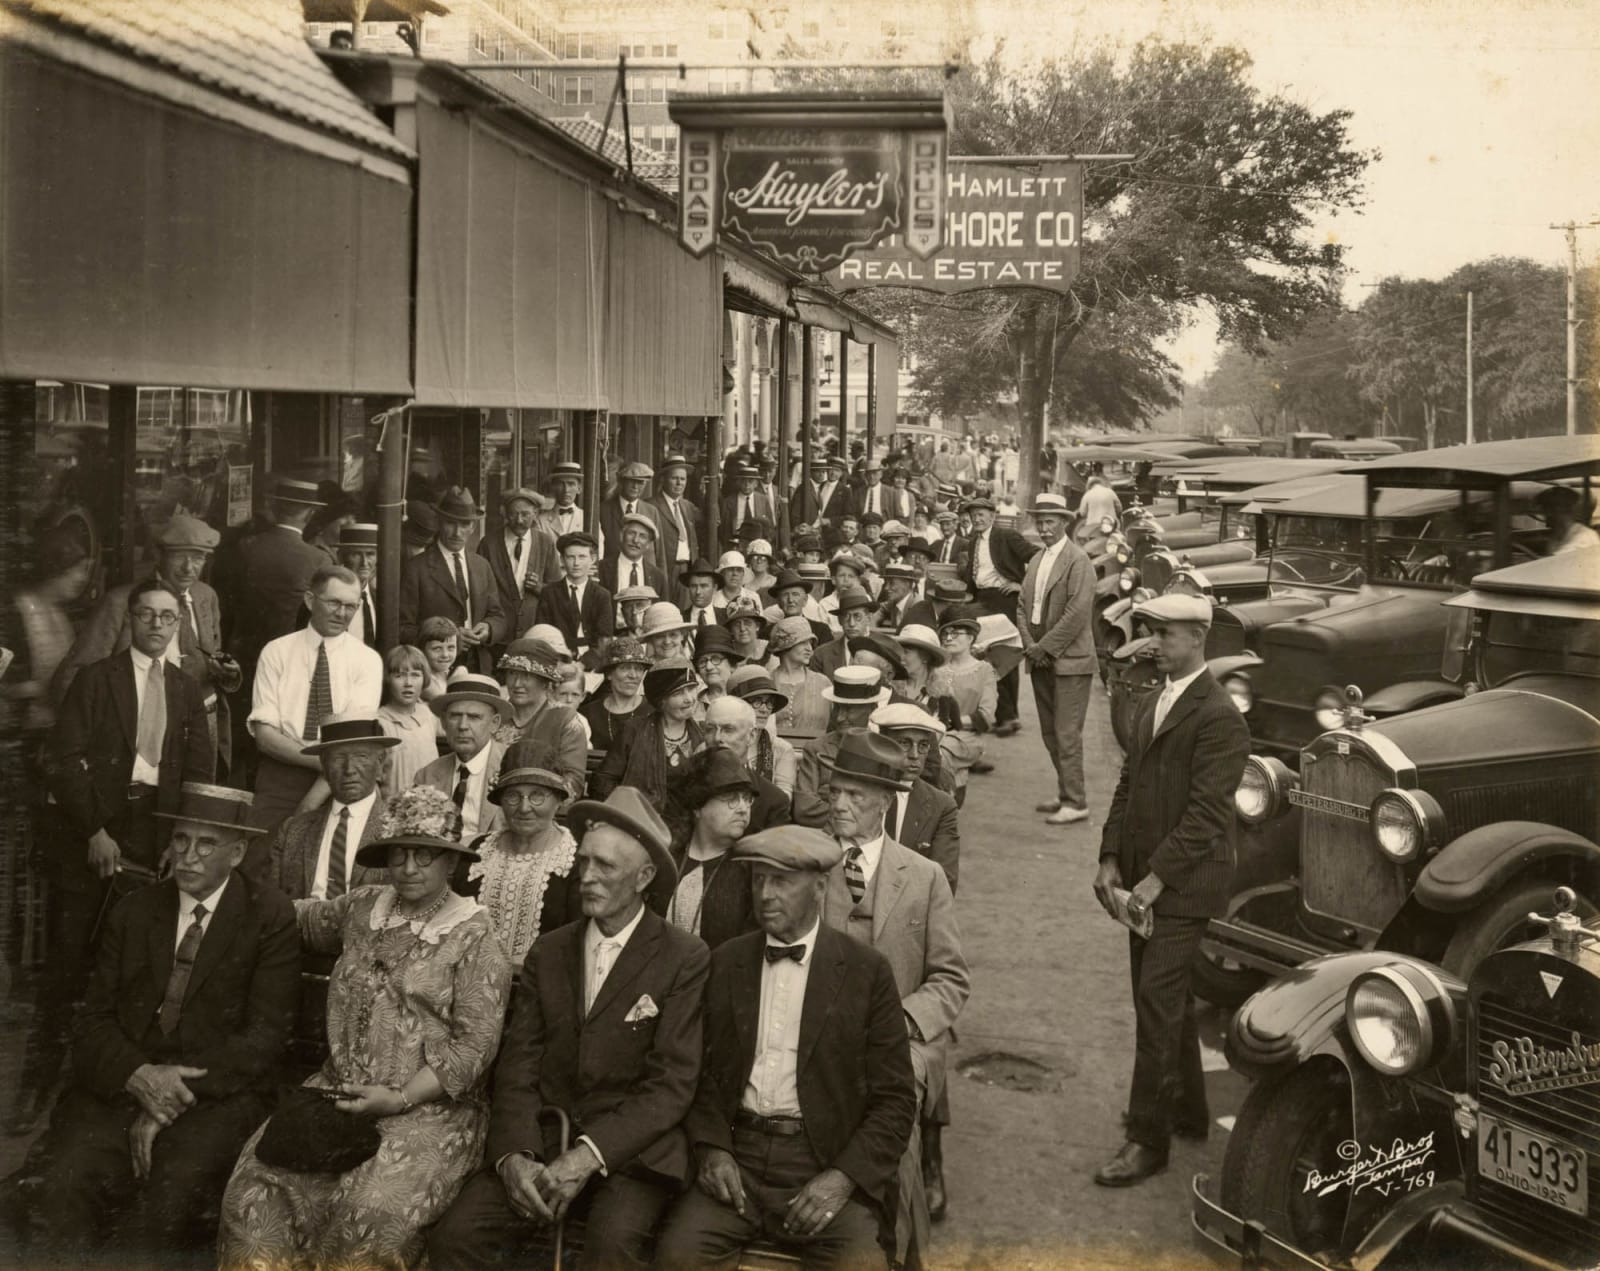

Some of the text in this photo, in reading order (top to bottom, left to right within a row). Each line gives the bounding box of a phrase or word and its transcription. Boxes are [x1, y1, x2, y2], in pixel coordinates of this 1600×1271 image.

[688, 141, 711, 228] SODAS
[728, 161, 889, 226] Huyler's
[913, 141, 937, 230] DRUGS
[948, 172, 1067, 197] HAMLETT
[945, 211, 1079, 247] HORE CO.
[839, 258, 1063, 280] REAL ESTATE
[1484, 1125, 1579, 1194] 41-933
[1496, 1168, 1567, 1206] OHIO-1925
